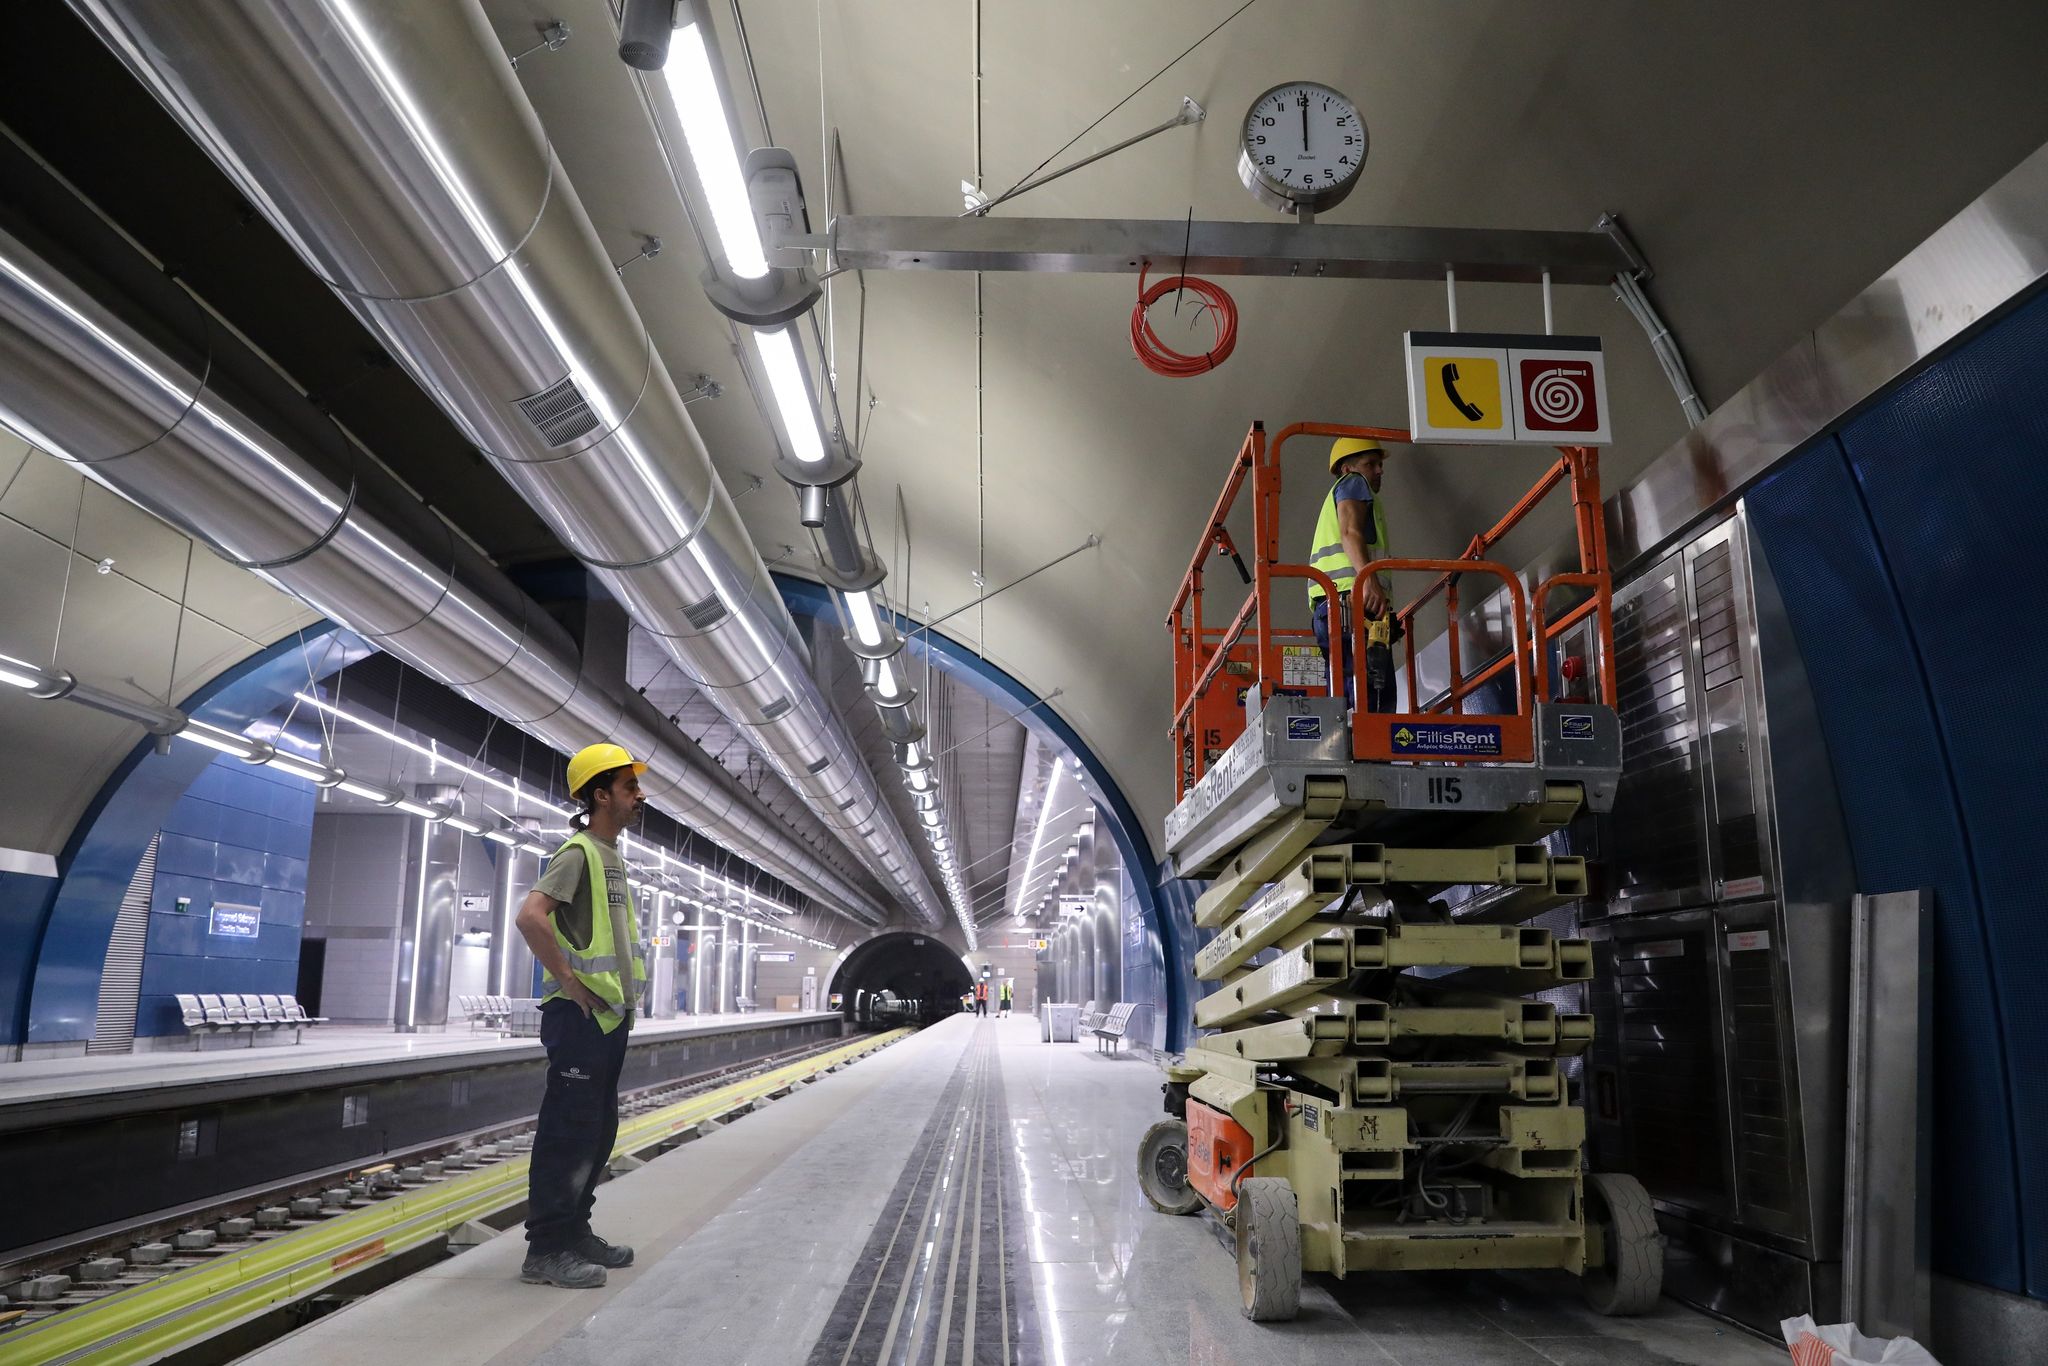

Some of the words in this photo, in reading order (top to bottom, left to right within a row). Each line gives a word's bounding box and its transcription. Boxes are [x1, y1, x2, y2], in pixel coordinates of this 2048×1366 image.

[1277, 103, 1284, 112] 11
[1322, 103, 1327, 112] 1
[1262, 117, 1275, 126] 10
[1336, 117, 1346, 127] 2
[1256, 135, 1266, 145] 9
[1344, 136, 1353, 145] 3
[1265, 155, 1275, 165] 8
[1339, 155, 1349, 165] 4
[1283, 168, 1292, 178] 7
[1324, 169, 1333, 178] 5
[1303, 174, 1313, 184] 6
[1416, 730, 1495, 744] FillisRent
[1428, 777, 1463, 804] 115
